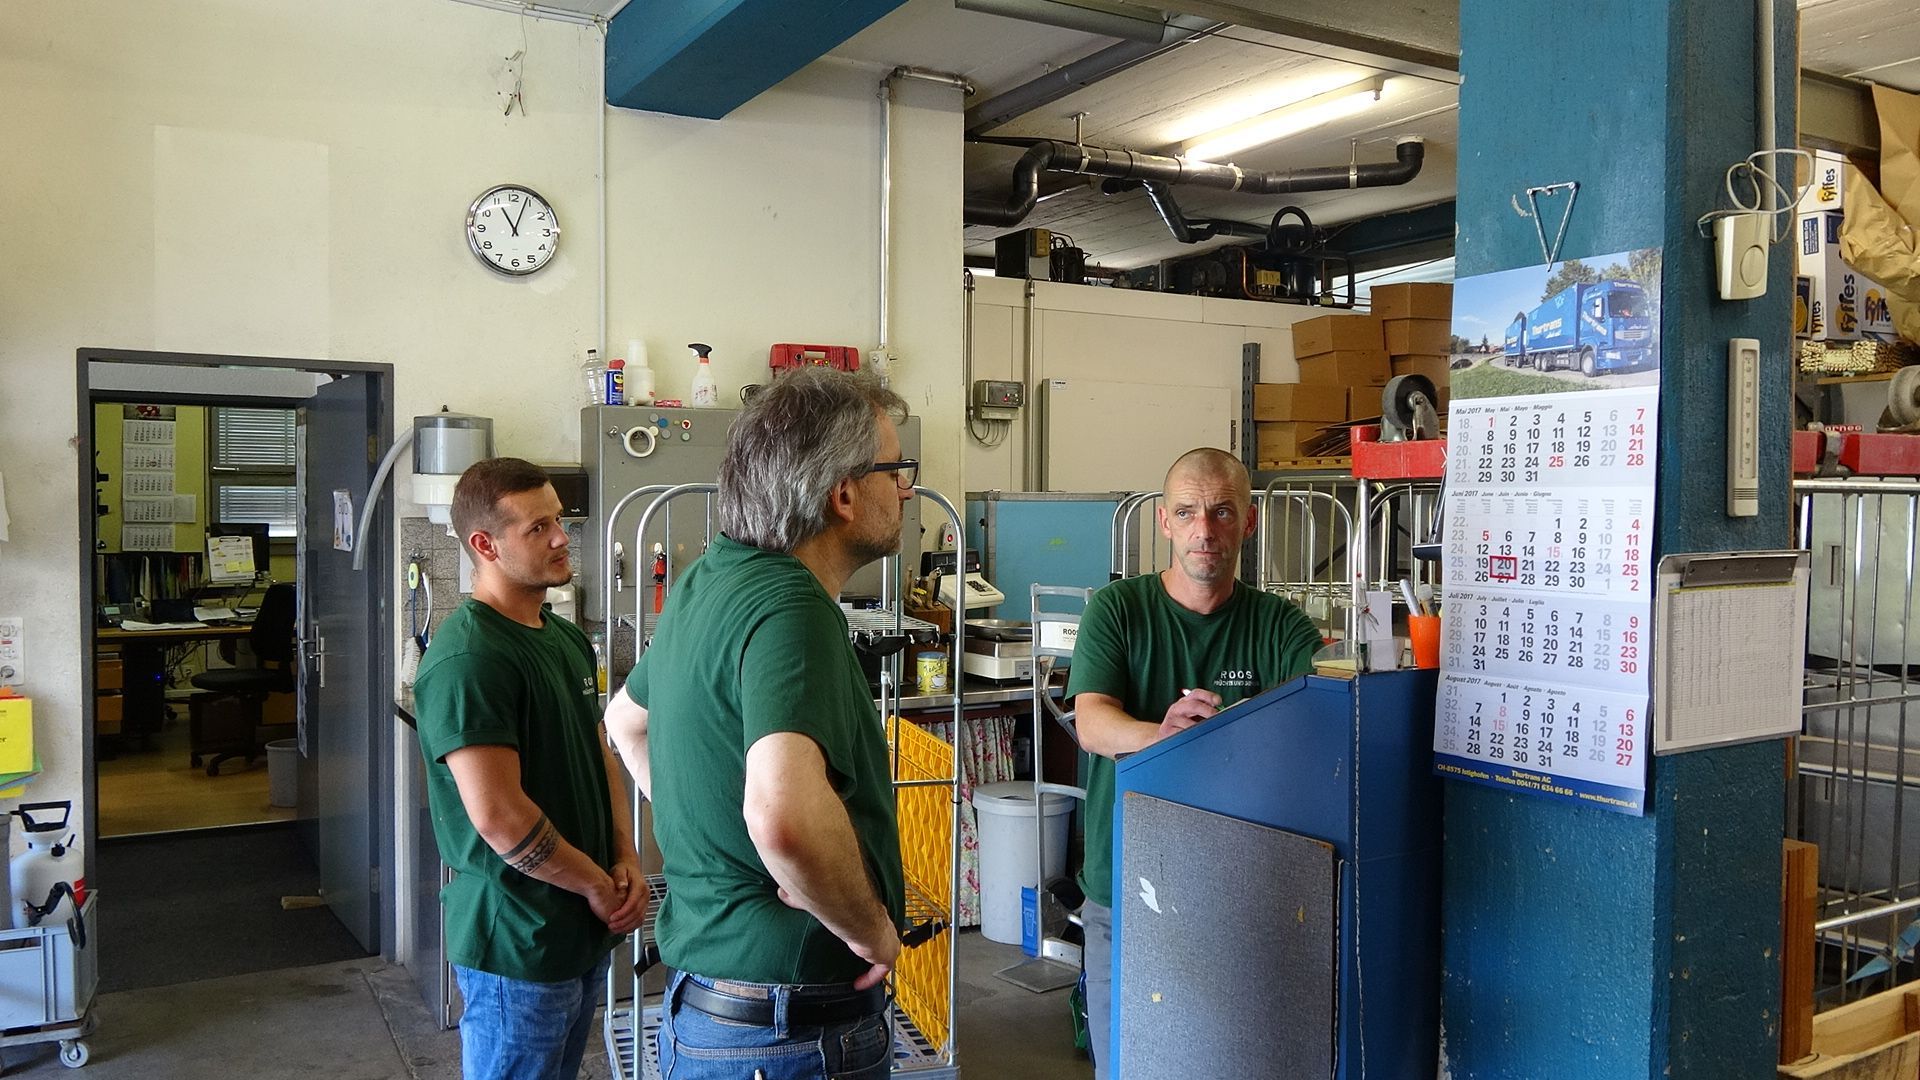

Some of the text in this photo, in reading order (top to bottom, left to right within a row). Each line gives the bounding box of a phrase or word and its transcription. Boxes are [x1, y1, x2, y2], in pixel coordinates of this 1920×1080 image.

[1822, 168, 1837, 202] fyffes
[508, 194, 519, 202] 12
[529, 199, 531, 207] 1
[537, 212, 545, 220] 2
[477, 224, 486, 232] 9
[542, 229, 550, 237] 3
[483, 241, 492, 249] 8
[496, 254, 503, 262] 7
[511, 259, 519, 267] 6
[527, 255, 536, 263] 5
[1840, 274, 1857, 332] fyffes
[1864, 295, 1891, 326] fyffe
[1489, 408, 1644, 427] 1 2 3 4 5 7
[1487, 424, 1644, 441] 8 9 10 11 12 14
[1481, 439, 1643, 455] 15 16 17 18 19 21
[1479, 454, 1643, 469] 22 23 24 25 26 28
[1478, 471, 1538, 482] 29 30 31
[1555, 518, 1640, 530] 1 2 4
[1483, 531, 1638, 546] 5 6 7 8 9 11
[1477, 544, 1639, 561] 12 13 14 15 16 18
[1476, 558, 1638, 576] 19 20 21 22 23 25
[1475, 571, 1488, 582] 26
[1521, 574, 1535, 585] 28
[1545, 575, 1559, 586] 29
[1569, 576, 1585, 588] 30
[1631, 580, 1638, 591] 2
[1480, 605, 1638, 628] 3 4 5 6 7 9
[1475, 618, 1637, 643] 10 11 12 13 14 16
[1474, 632, 1637, 658] 17 18 19 20 21 23
[1472, 645, 1637, 673] 24 25 26 27 28 30
[1473, 659, 1485, 670] 31
[1220, 671, 1253, 679] ROOS
[1445, 675, 1481, 685] August 2017
[1501, 692, 1634, 721] 1 2 3 4 6
[1476, 702, 1633, 736] 7 8 9 10 11 13
[1470, 716, 1633, 751] 14 15 16 17 18 20
[1467, 742, 1551, 767] 28 29 30 31
[1468, 729, 1632, 766] 21 22 23 24 25 27
[1495, 774, 1516, 784] Telefon
[1579, 792, 1638, 808] www.thurtrans.ch
